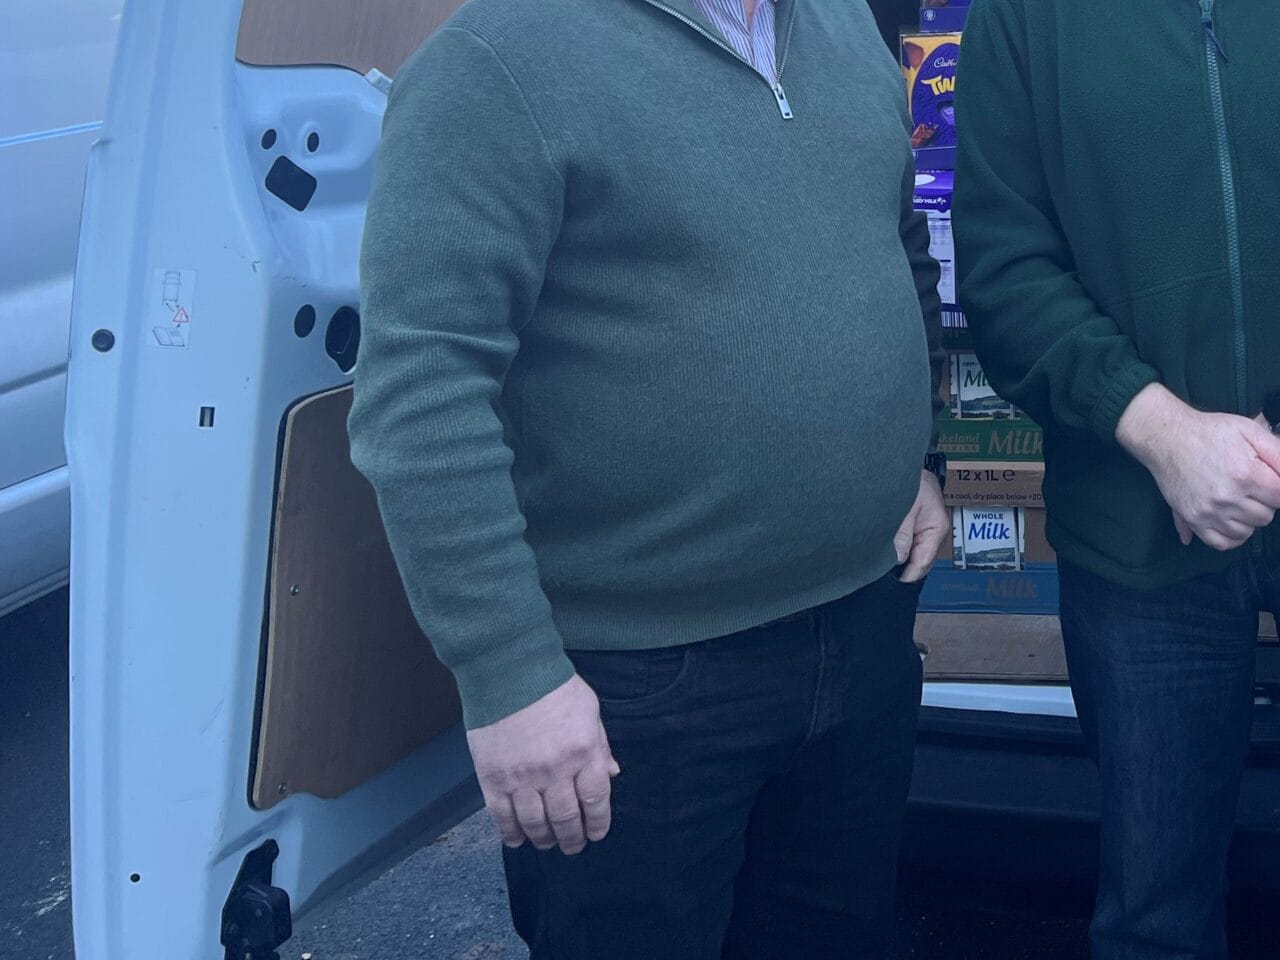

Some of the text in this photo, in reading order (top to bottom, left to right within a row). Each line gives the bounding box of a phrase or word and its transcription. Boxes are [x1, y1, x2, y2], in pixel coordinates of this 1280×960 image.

[987, 431, 1042, 456] Milk
[957, 469, 971, 482] 12
[974, 472, 984, 482] x
[986, 470, 999, 482] 1L
[967, 522, 1011, 541] Milk
